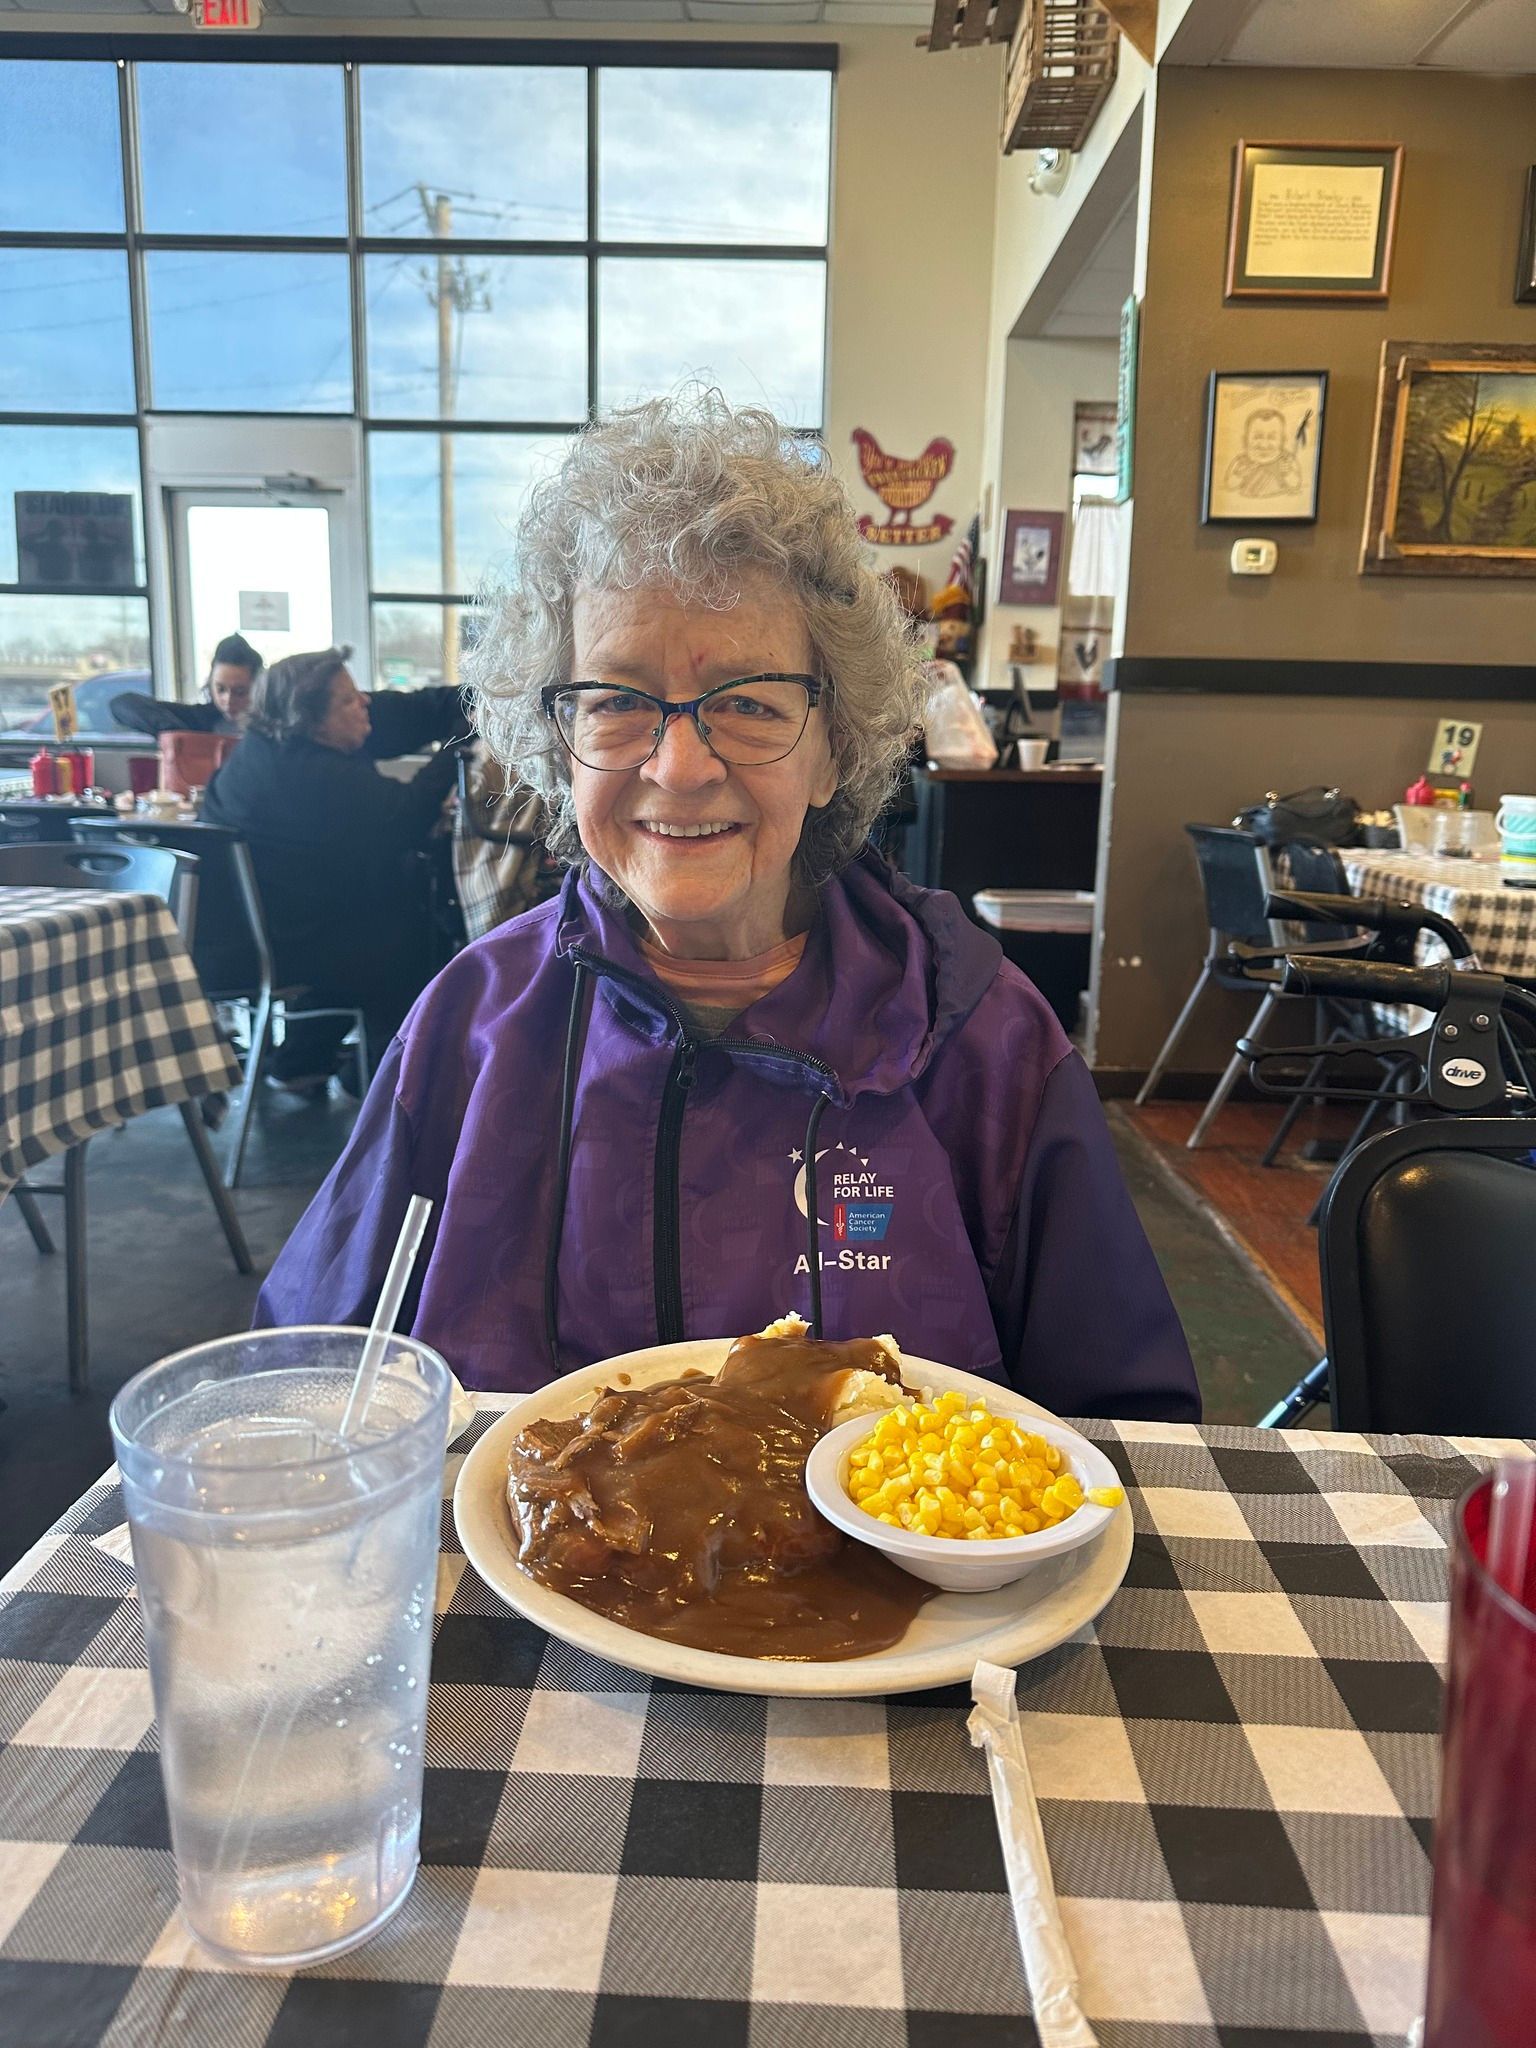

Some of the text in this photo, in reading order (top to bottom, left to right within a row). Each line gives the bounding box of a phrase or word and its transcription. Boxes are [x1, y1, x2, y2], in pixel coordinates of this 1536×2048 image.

[204, 0, 249, 25] EXIT
[1444, 725, 1475, 746] 19
[1446, 1066, 1481, 1080] drive
[833, 1173, 877, 1185] RELAY
[833, 1186, 894, 1198] FOR LIFE
[793, 1249, 892, 1274] Al-Star
